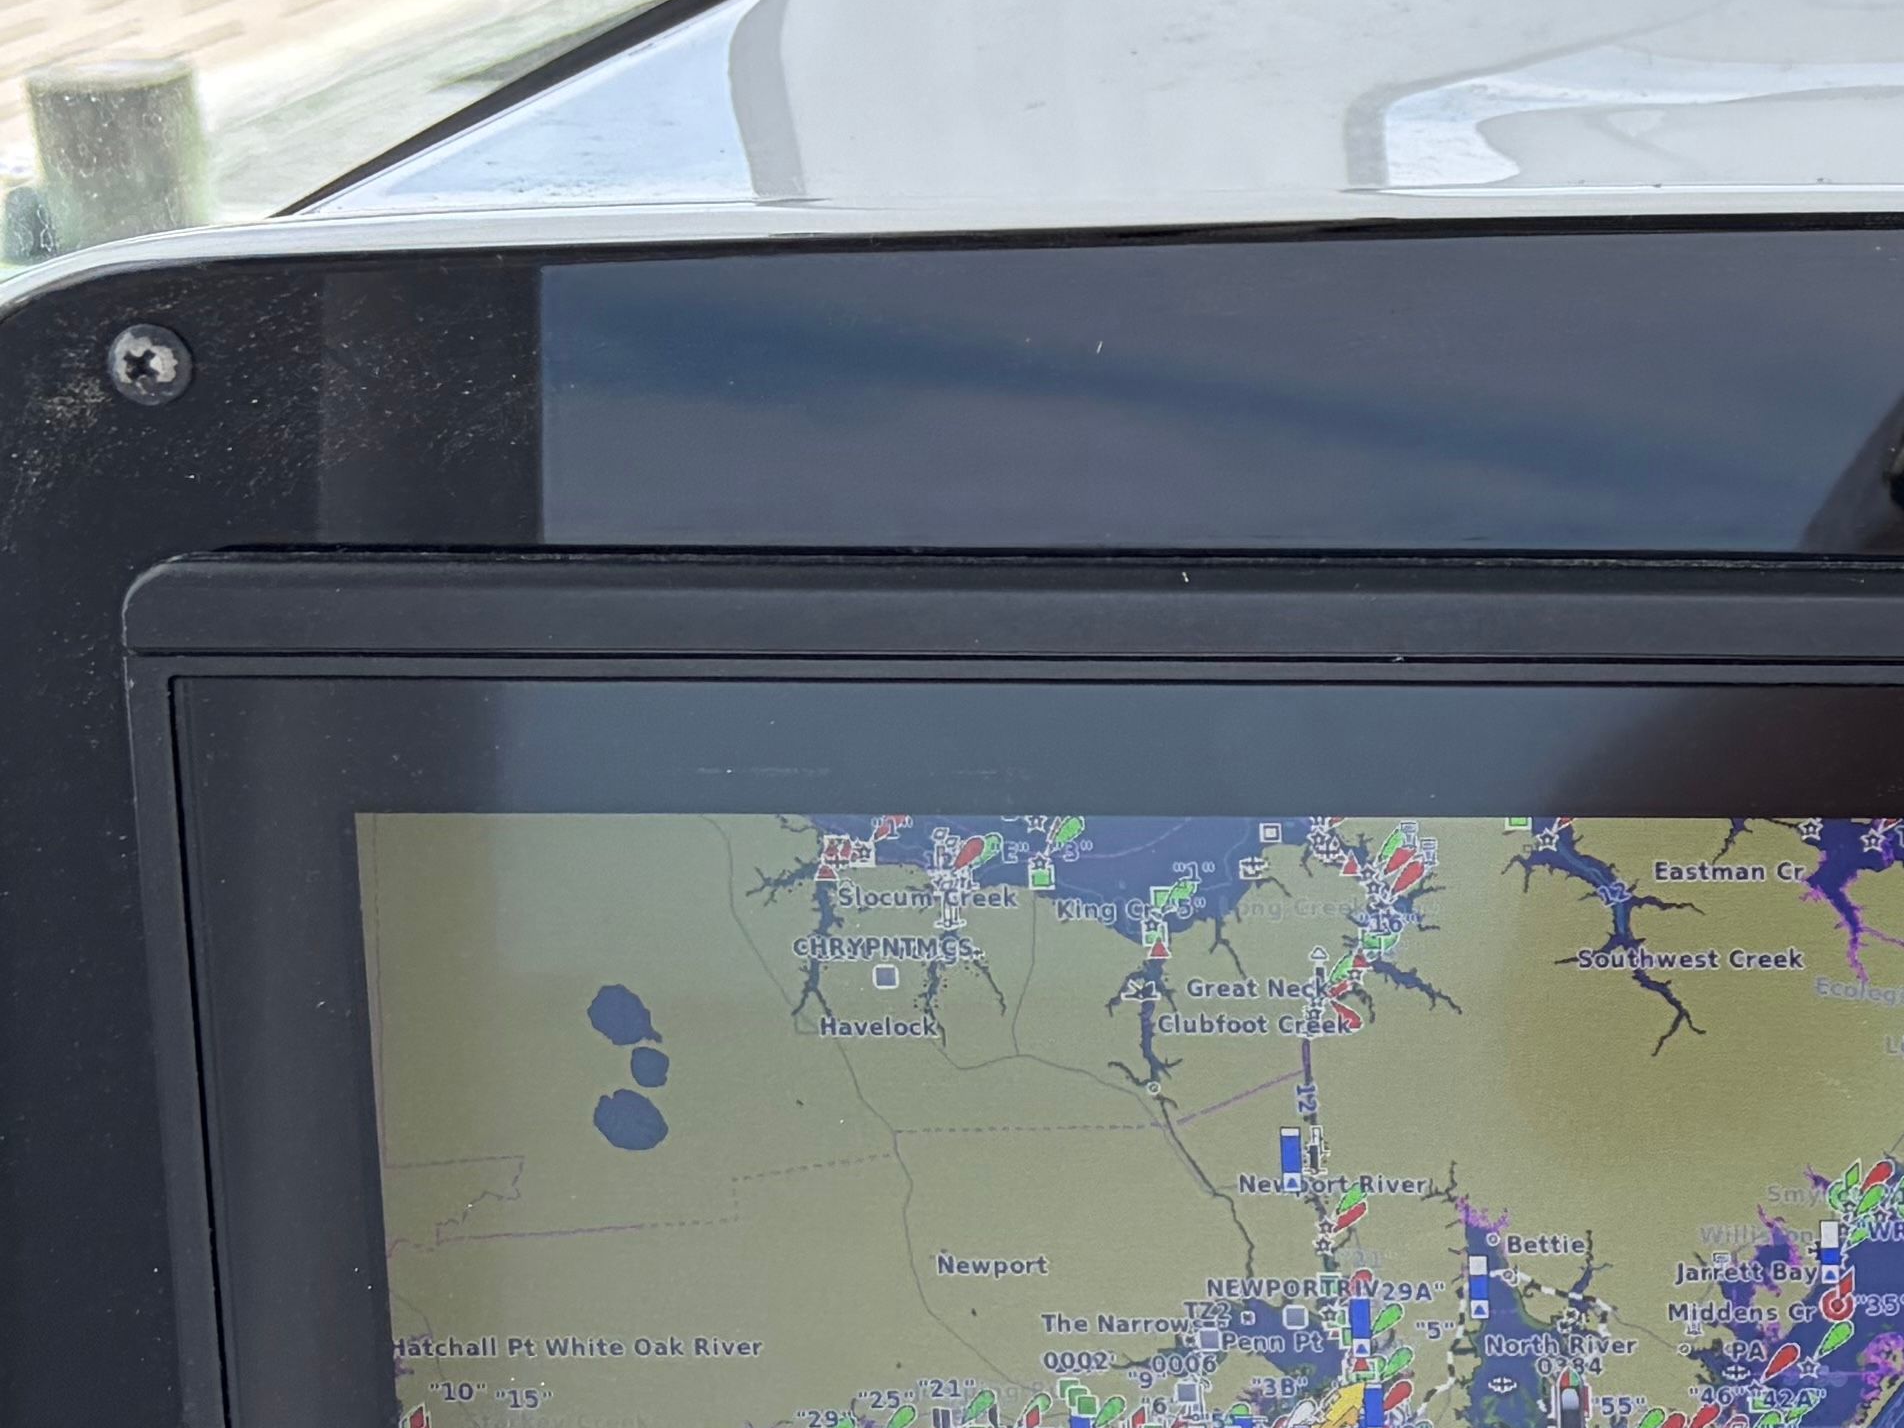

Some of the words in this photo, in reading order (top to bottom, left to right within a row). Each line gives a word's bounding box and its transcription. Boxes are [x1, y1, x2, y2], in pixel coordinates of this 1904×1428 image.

[1654, 861, 1765, 882] Eastman
[1776, 861, 1804, 882] Cr
[838, 885, 933, 909] Slocum
[1057, 900, 1117, 924] King
[1577, 948, 1720, 970] Southwest
[1729, 948, 1804, 970] Creek
[1187, 977, 1258, 999] Great
[820, 1015, 938, 1037] Havelock
[1159, 1013, 1269, 1035] Clubfoot
[1359, 1174, 1428, 1195] River
[1507, 1235, 1586, 1255] Bettie
[937, 1255, 1049, 1279] Newport
[1675, 1262, 1764, 1286] Jarrett
[1776, 1262, 1819, 1286] Bay
[1668, 1301, 1778, 1322] Middens
[1041, 1313, 1089, 1334] The
[507, 1337, 536, 1357] Pt
[545, 1336, 624, 1357] White
[634, 1336, 684, 1357] Oak
[694, 1336, 763, 1357] River
[1221, 1332, 1285, 1353] Penn
[1294, 1332, 1323, 1353] Pt
[1485, 1335, 1560, 1356] North
[1570, 1335, 1638, 1356] River
